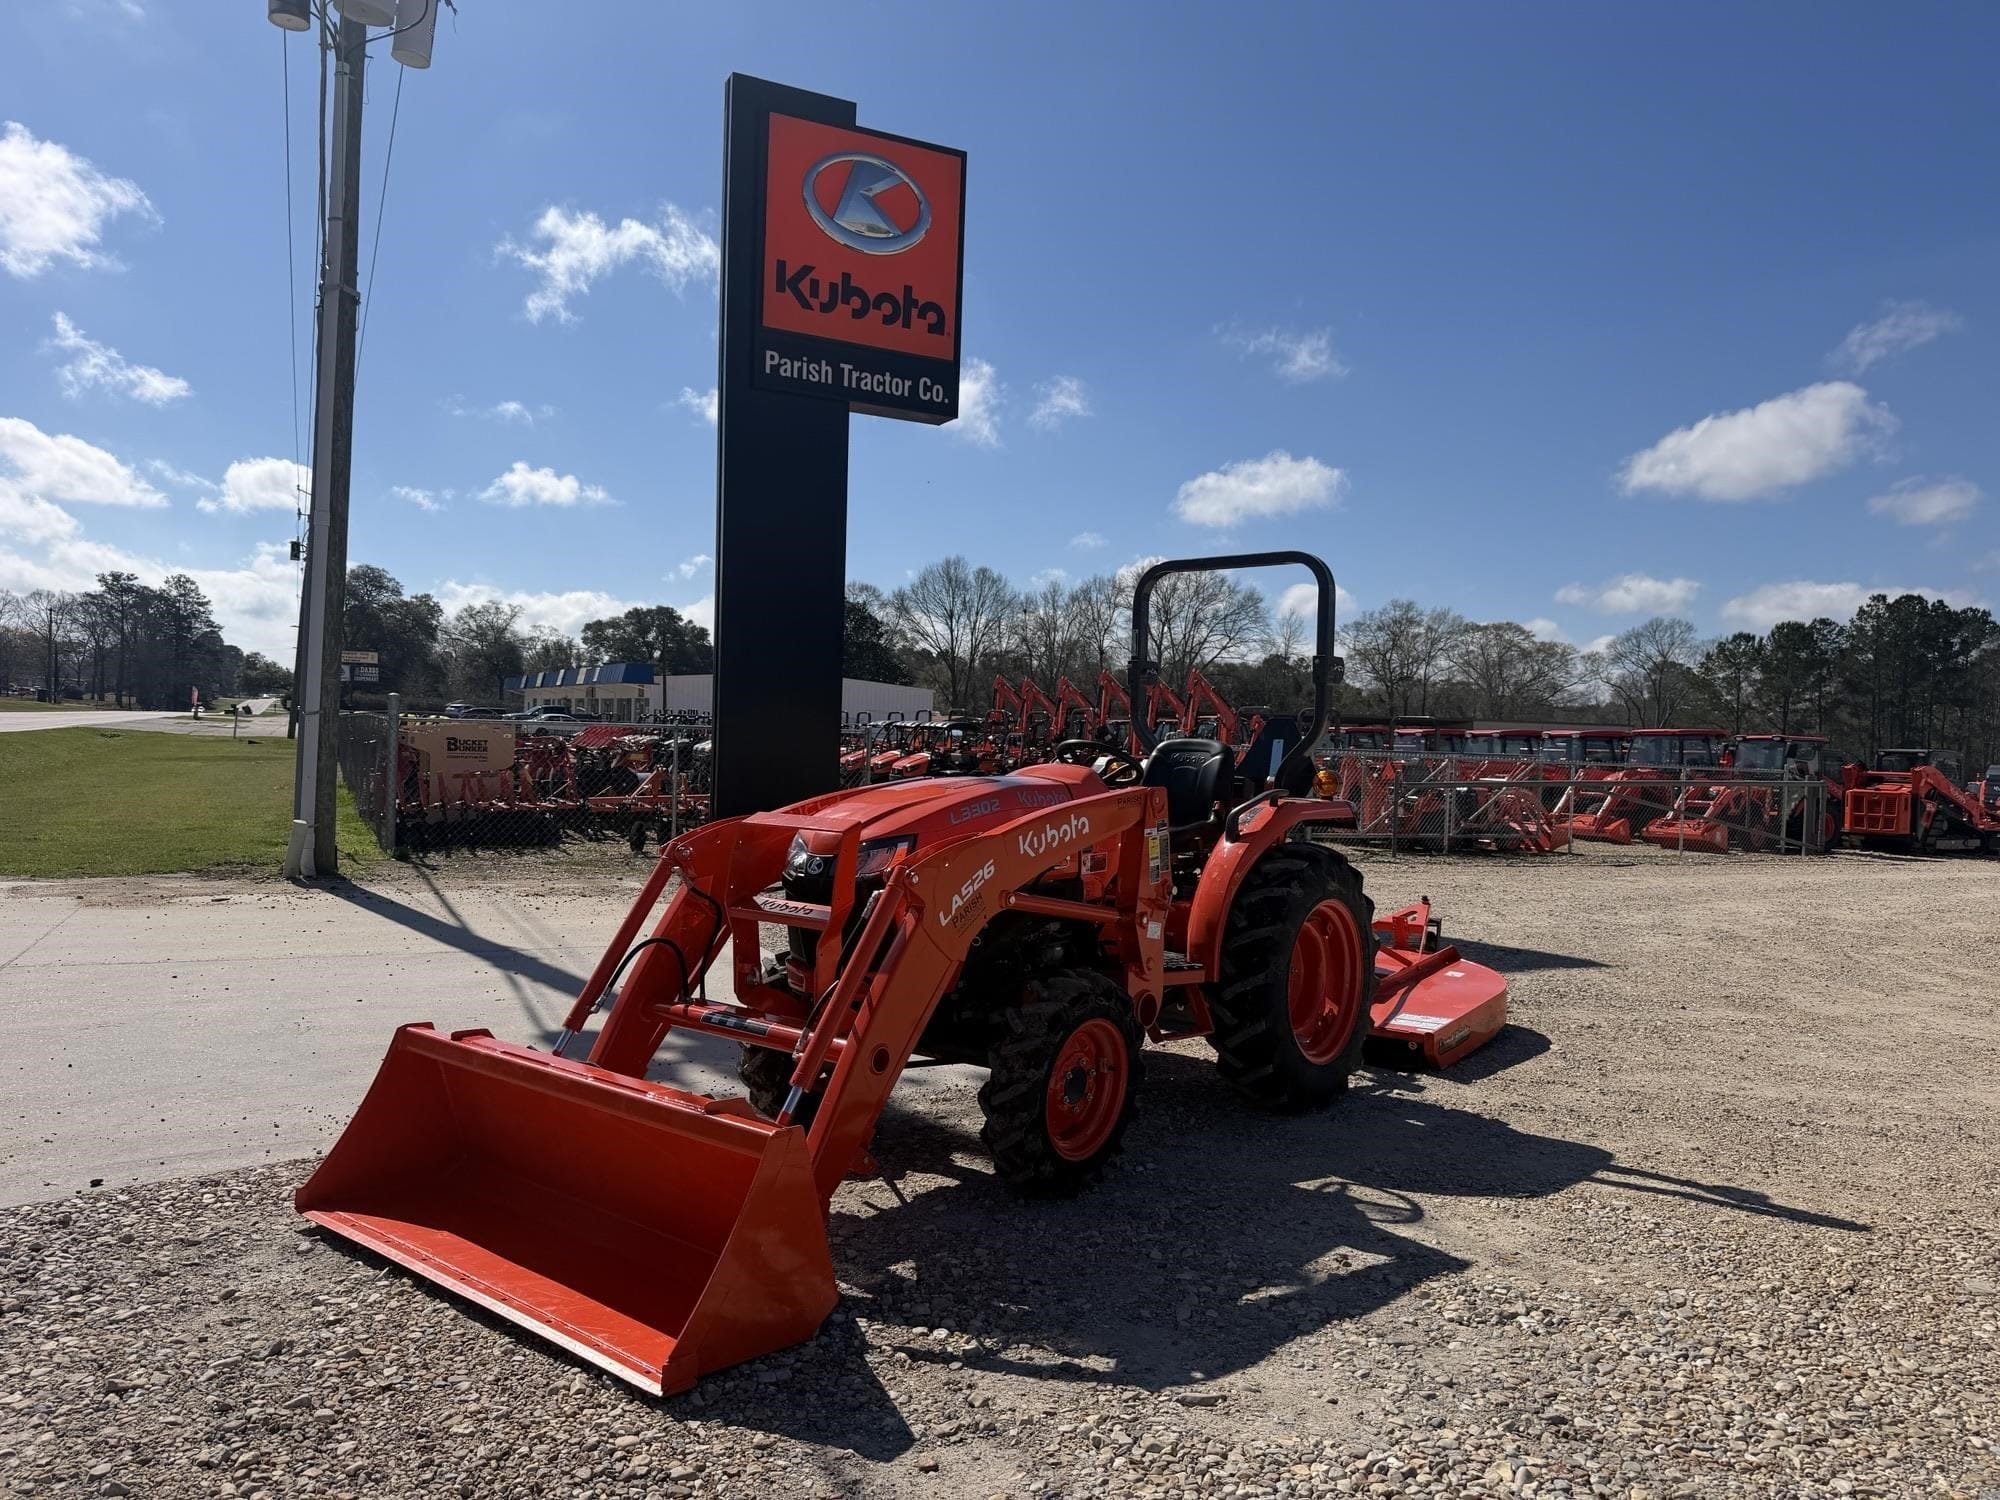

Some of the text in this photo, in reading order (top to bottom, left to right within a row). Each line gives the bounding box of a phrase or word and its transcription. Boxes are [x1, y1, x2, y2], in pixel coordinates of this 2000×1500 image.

[775, 259, 946, 336] Kubota
[764, 350, 949, 404] Parish Tractor Co.
[950, 798, 1001, 825] L3302
[1017, 790, 1067, 808] Kubota
[1018, 814, 1090, 857] Kubota
[760, 900, 814, 915] Kubota
[938, 858, 995, 927] LA526
[950, 892, 984, 929] PARISH
